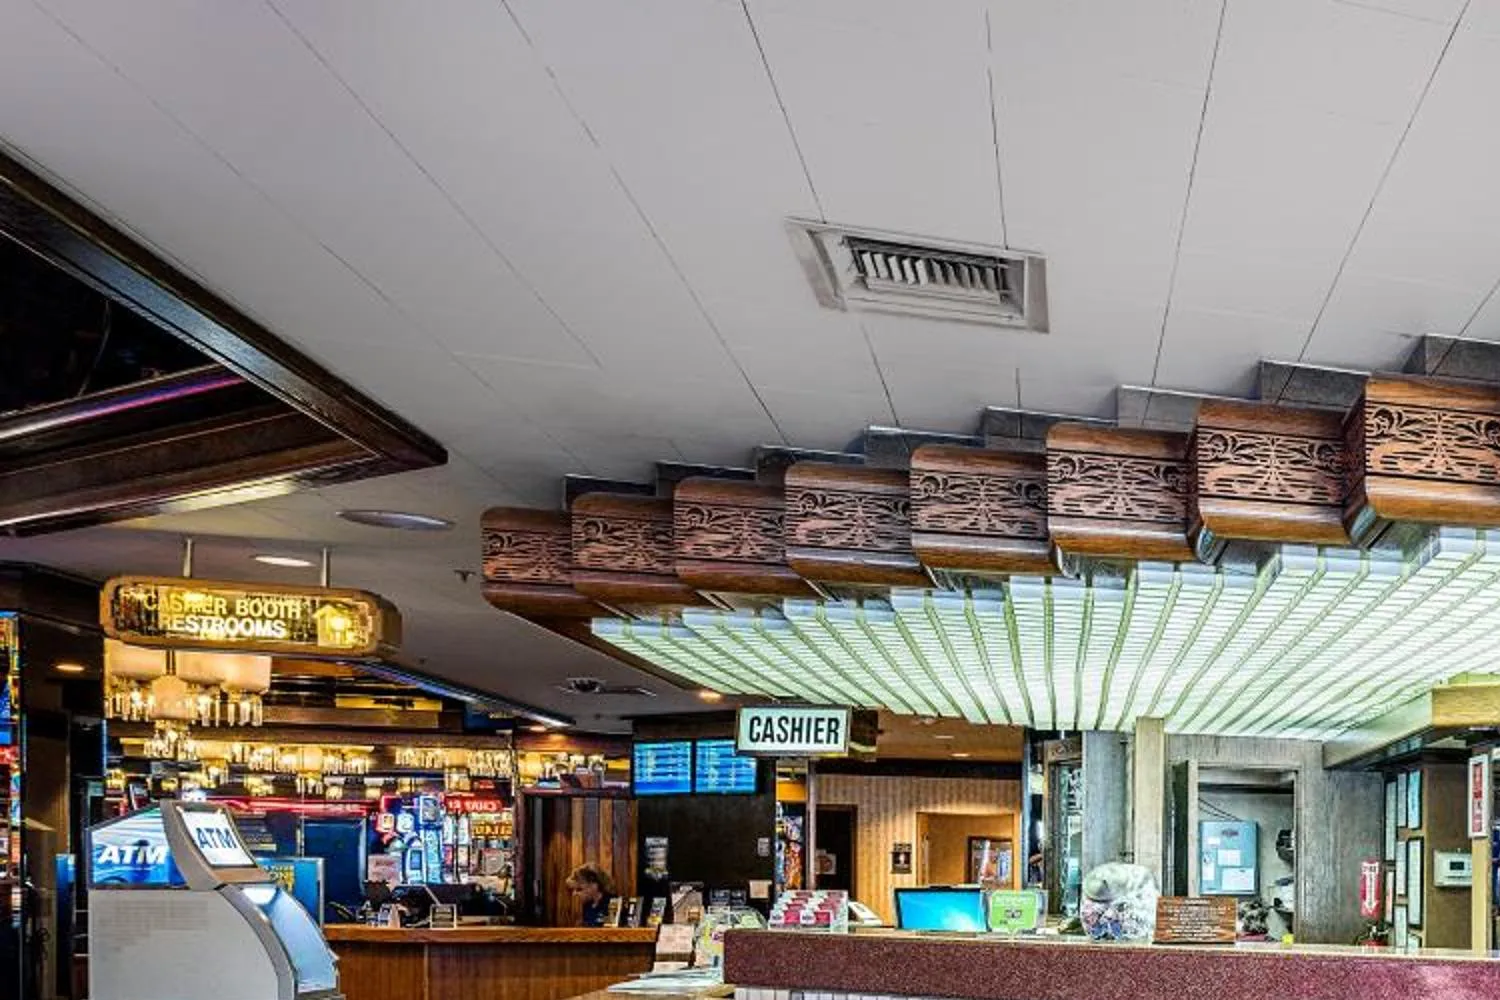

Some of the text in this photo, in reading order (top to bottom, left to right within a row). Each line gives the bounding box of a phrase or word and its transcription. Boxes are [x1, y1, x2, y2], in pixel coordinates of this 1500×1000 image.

[235, 599, 301, 620] BOOTH
[160, 614, 287, 639] RESTROOMS
[748, 715, 841, 745] CASHIER
[194, 826, 239, 850] ATM
[97, 844, 170, 865] ATM
